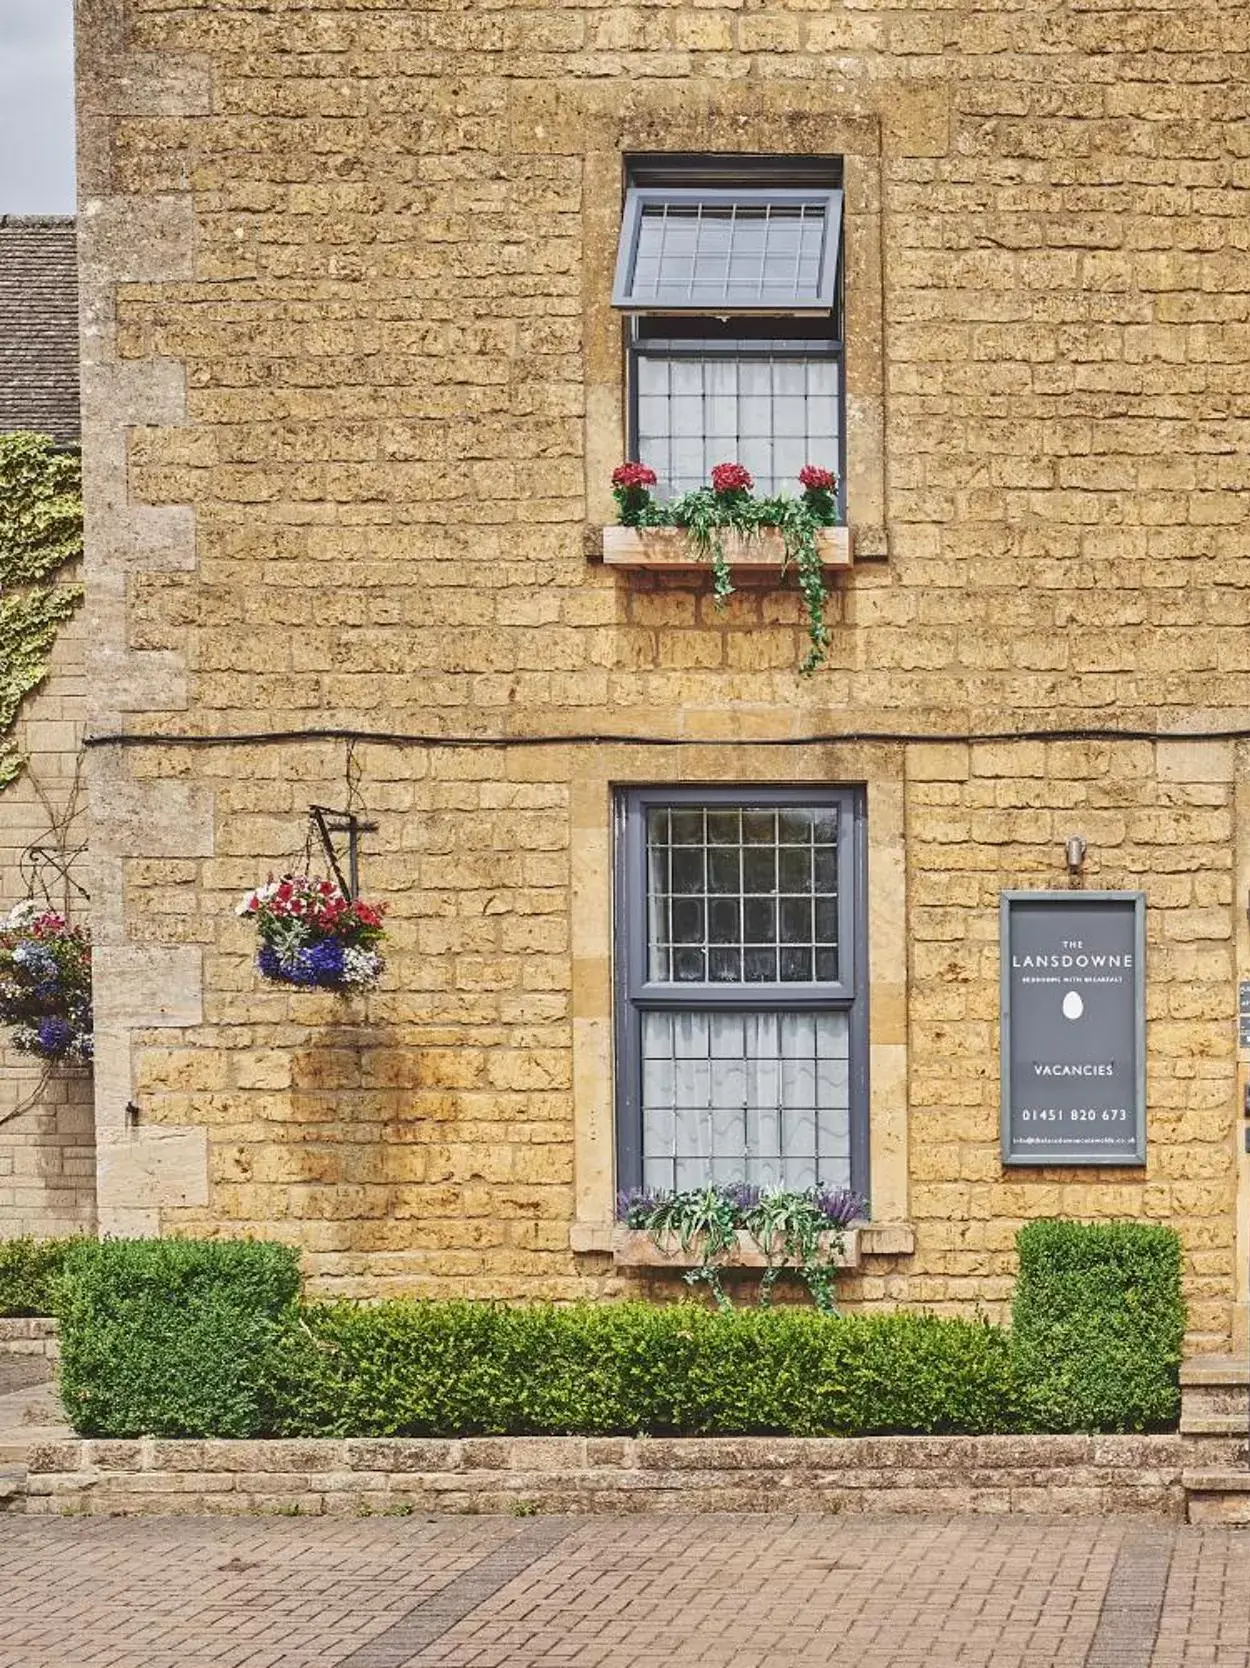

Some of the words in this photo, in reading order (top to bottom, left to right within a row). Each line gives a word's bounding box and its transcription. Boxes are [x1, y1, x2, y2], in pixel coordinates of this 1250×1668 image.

[1062, 940, 1084, 949] THE
[1012, 955, 1134, 968] LANSDOWNE
[1034, 1064, 1114, 1076] VACANCIES
[1022, 1109, 1063, 1121] 01451
[1070, 1109, 1096, 1121] 820
[1101, 1109, 1127, 1121] 673
